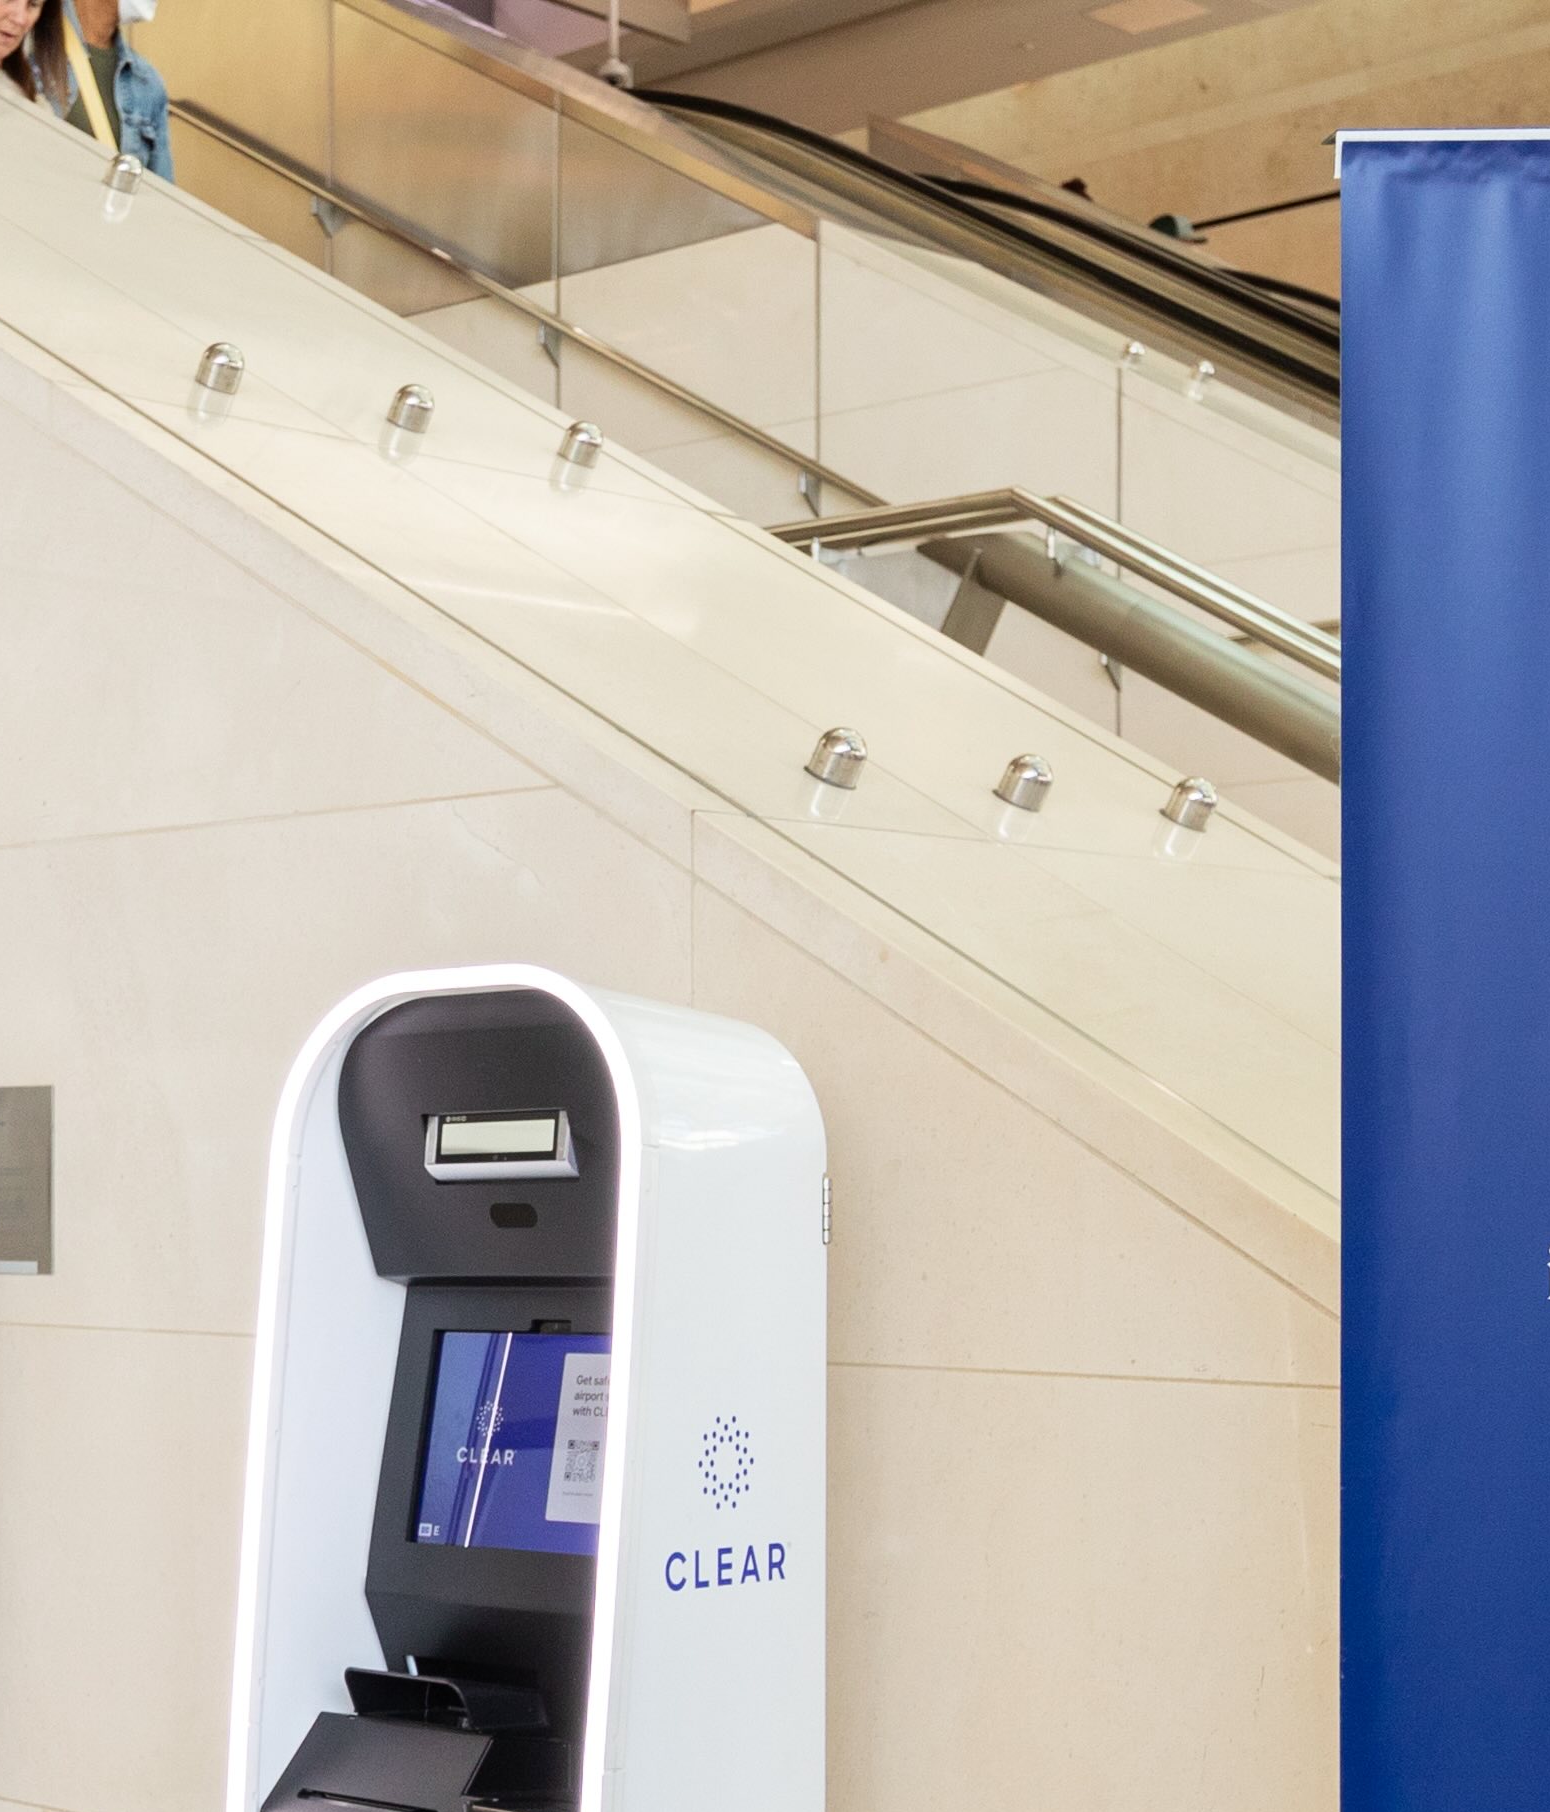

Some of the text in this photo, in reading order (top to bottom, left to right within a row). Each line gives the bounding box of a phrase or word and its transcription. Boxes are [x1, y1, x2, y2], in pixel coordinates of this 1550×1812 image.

[576, 1375, 592, 1386] Get
[574, 1391, 603, 1404] airport
[572, 1406, 591, 1417] with
[456, 1447, 515, 1466] CLEAR
[665, 1542, 786, 1592] CLEAR
